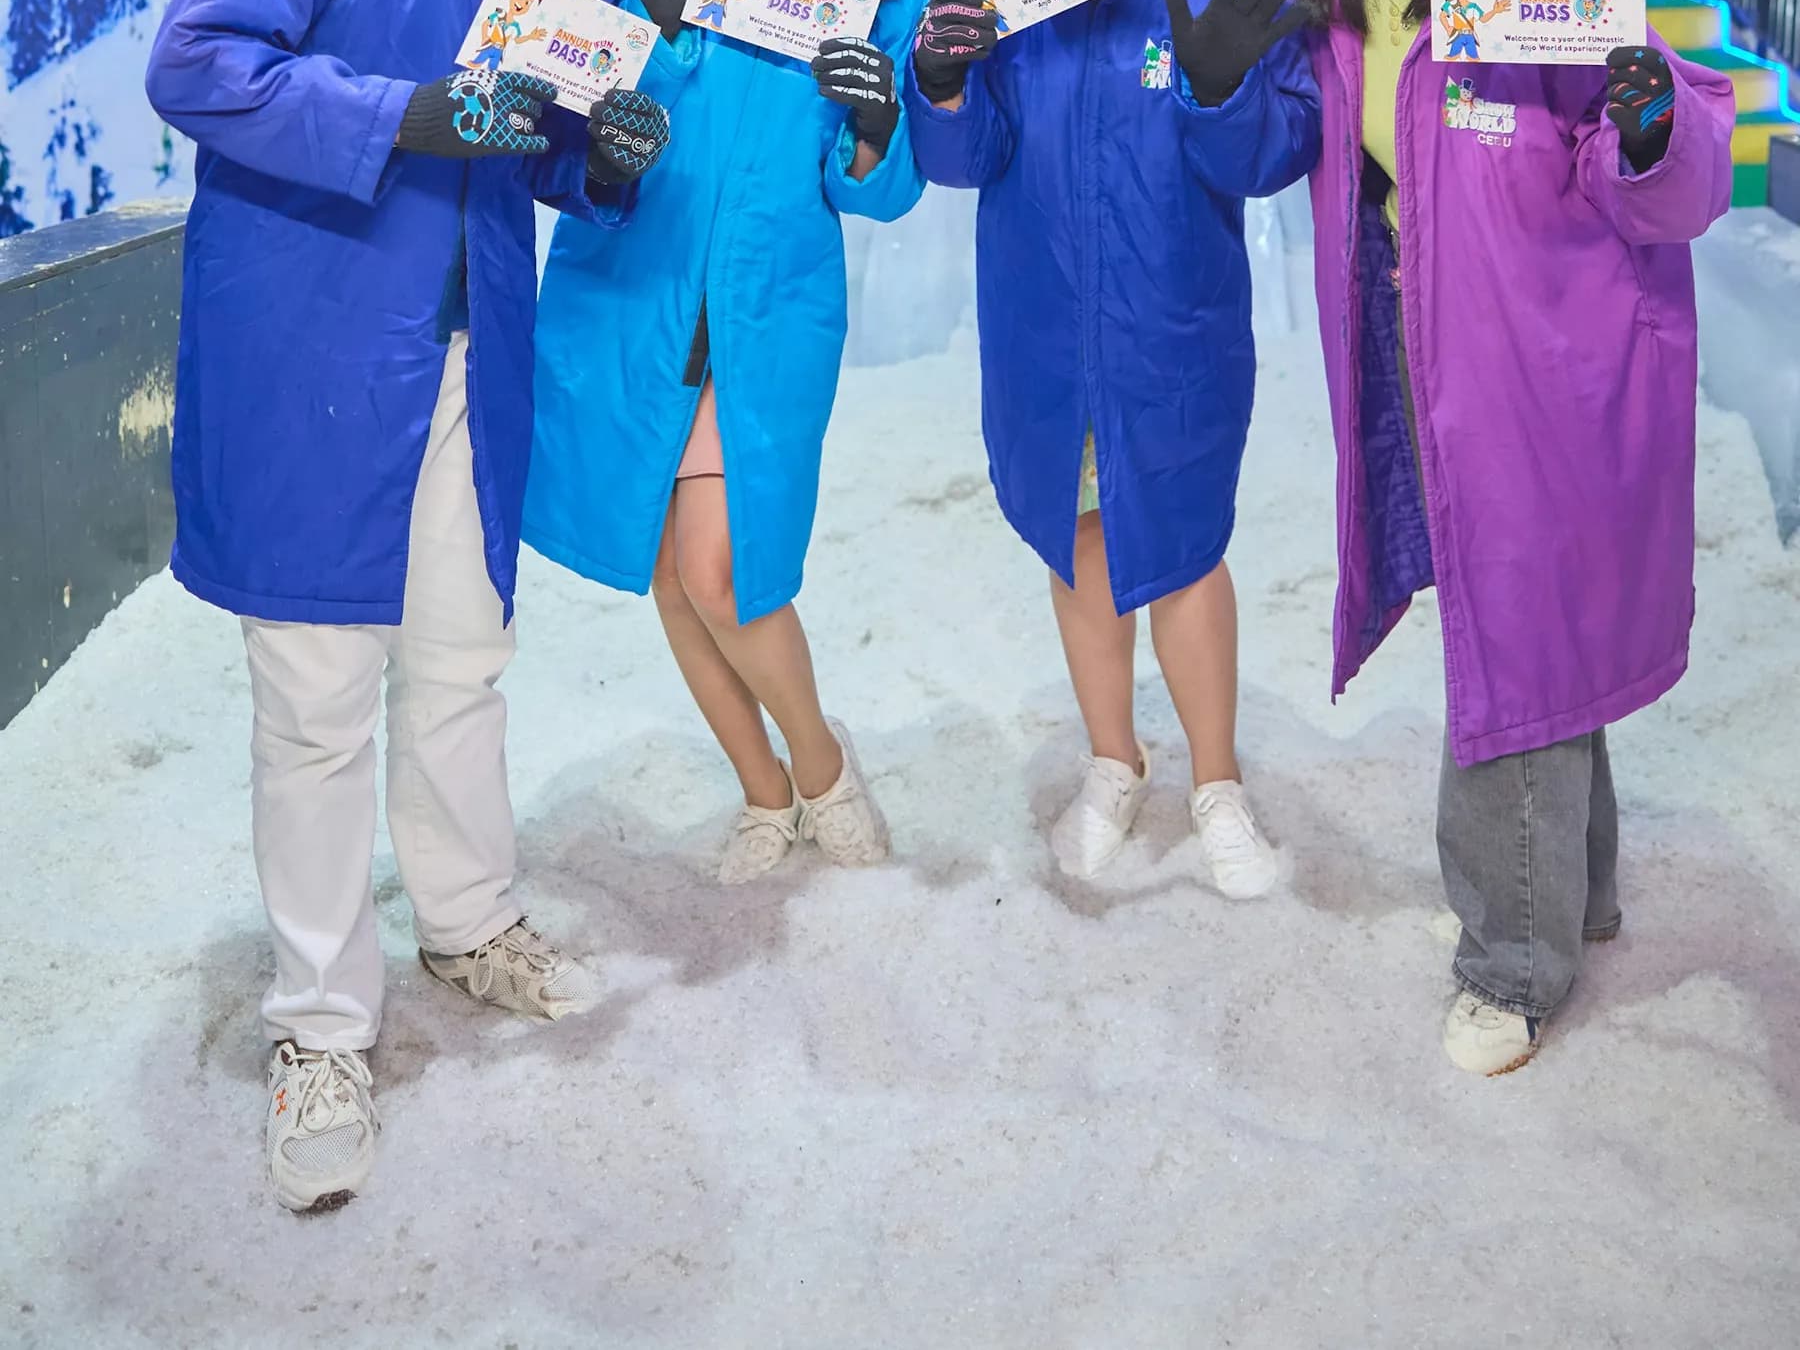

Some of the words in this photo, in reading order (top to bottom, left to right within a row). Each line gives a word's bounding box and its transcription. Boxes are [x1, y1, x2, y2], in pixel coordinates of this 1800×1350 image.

[1520, 3, 1571, 22] PASS
[749, 15, 777, 29] Welcome
[792, 31, 806, 39] year
[759, 27, 773, 37] Anjo
[775, 31, 793, 43] World
[555, 29, 593, 52] ANNUAL
[594, 40, 613, 49] FUN
[1520, 44, 1537, 52] Anjo
[1564, 45, 1609, 53] experience!
[548, 39, 589, 68] PASS
[526, 61, 552, 77] Welcome
